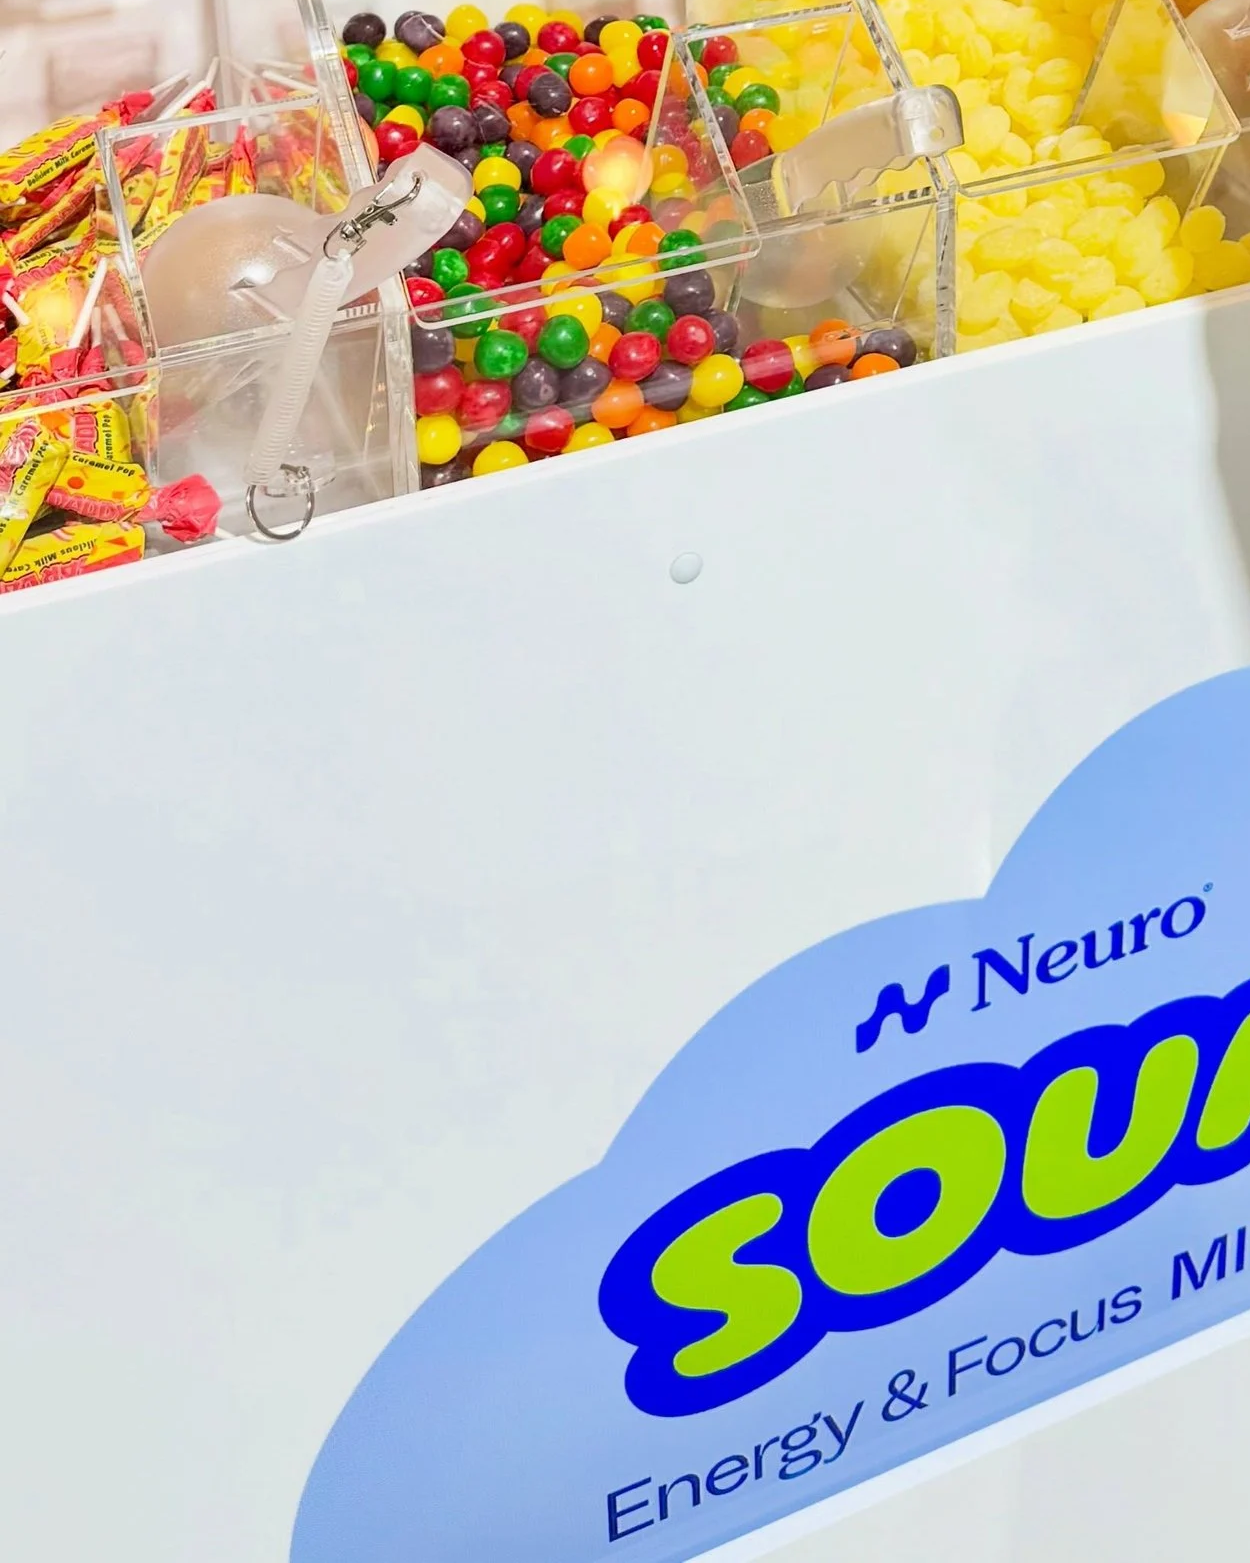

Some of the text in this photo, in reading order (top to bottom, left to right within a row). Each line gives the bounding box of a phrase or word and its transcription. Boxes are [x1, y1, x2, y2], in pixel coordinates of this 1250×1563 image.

[55, 154, 69, 168] Milk
[71, 141, 95, 159] Carame
[103, 429, 113, 460] aramel
[72, 454, 135, 477] Caramel Pop
[34, 552, 57, 568] Milk
[971, 896, 1206, 1013] Neuro
[606, 1400, 865, 1543] Energy
[880, 1368, 929, 1423] &
[947, 1285, 1143, 1398] Focus
